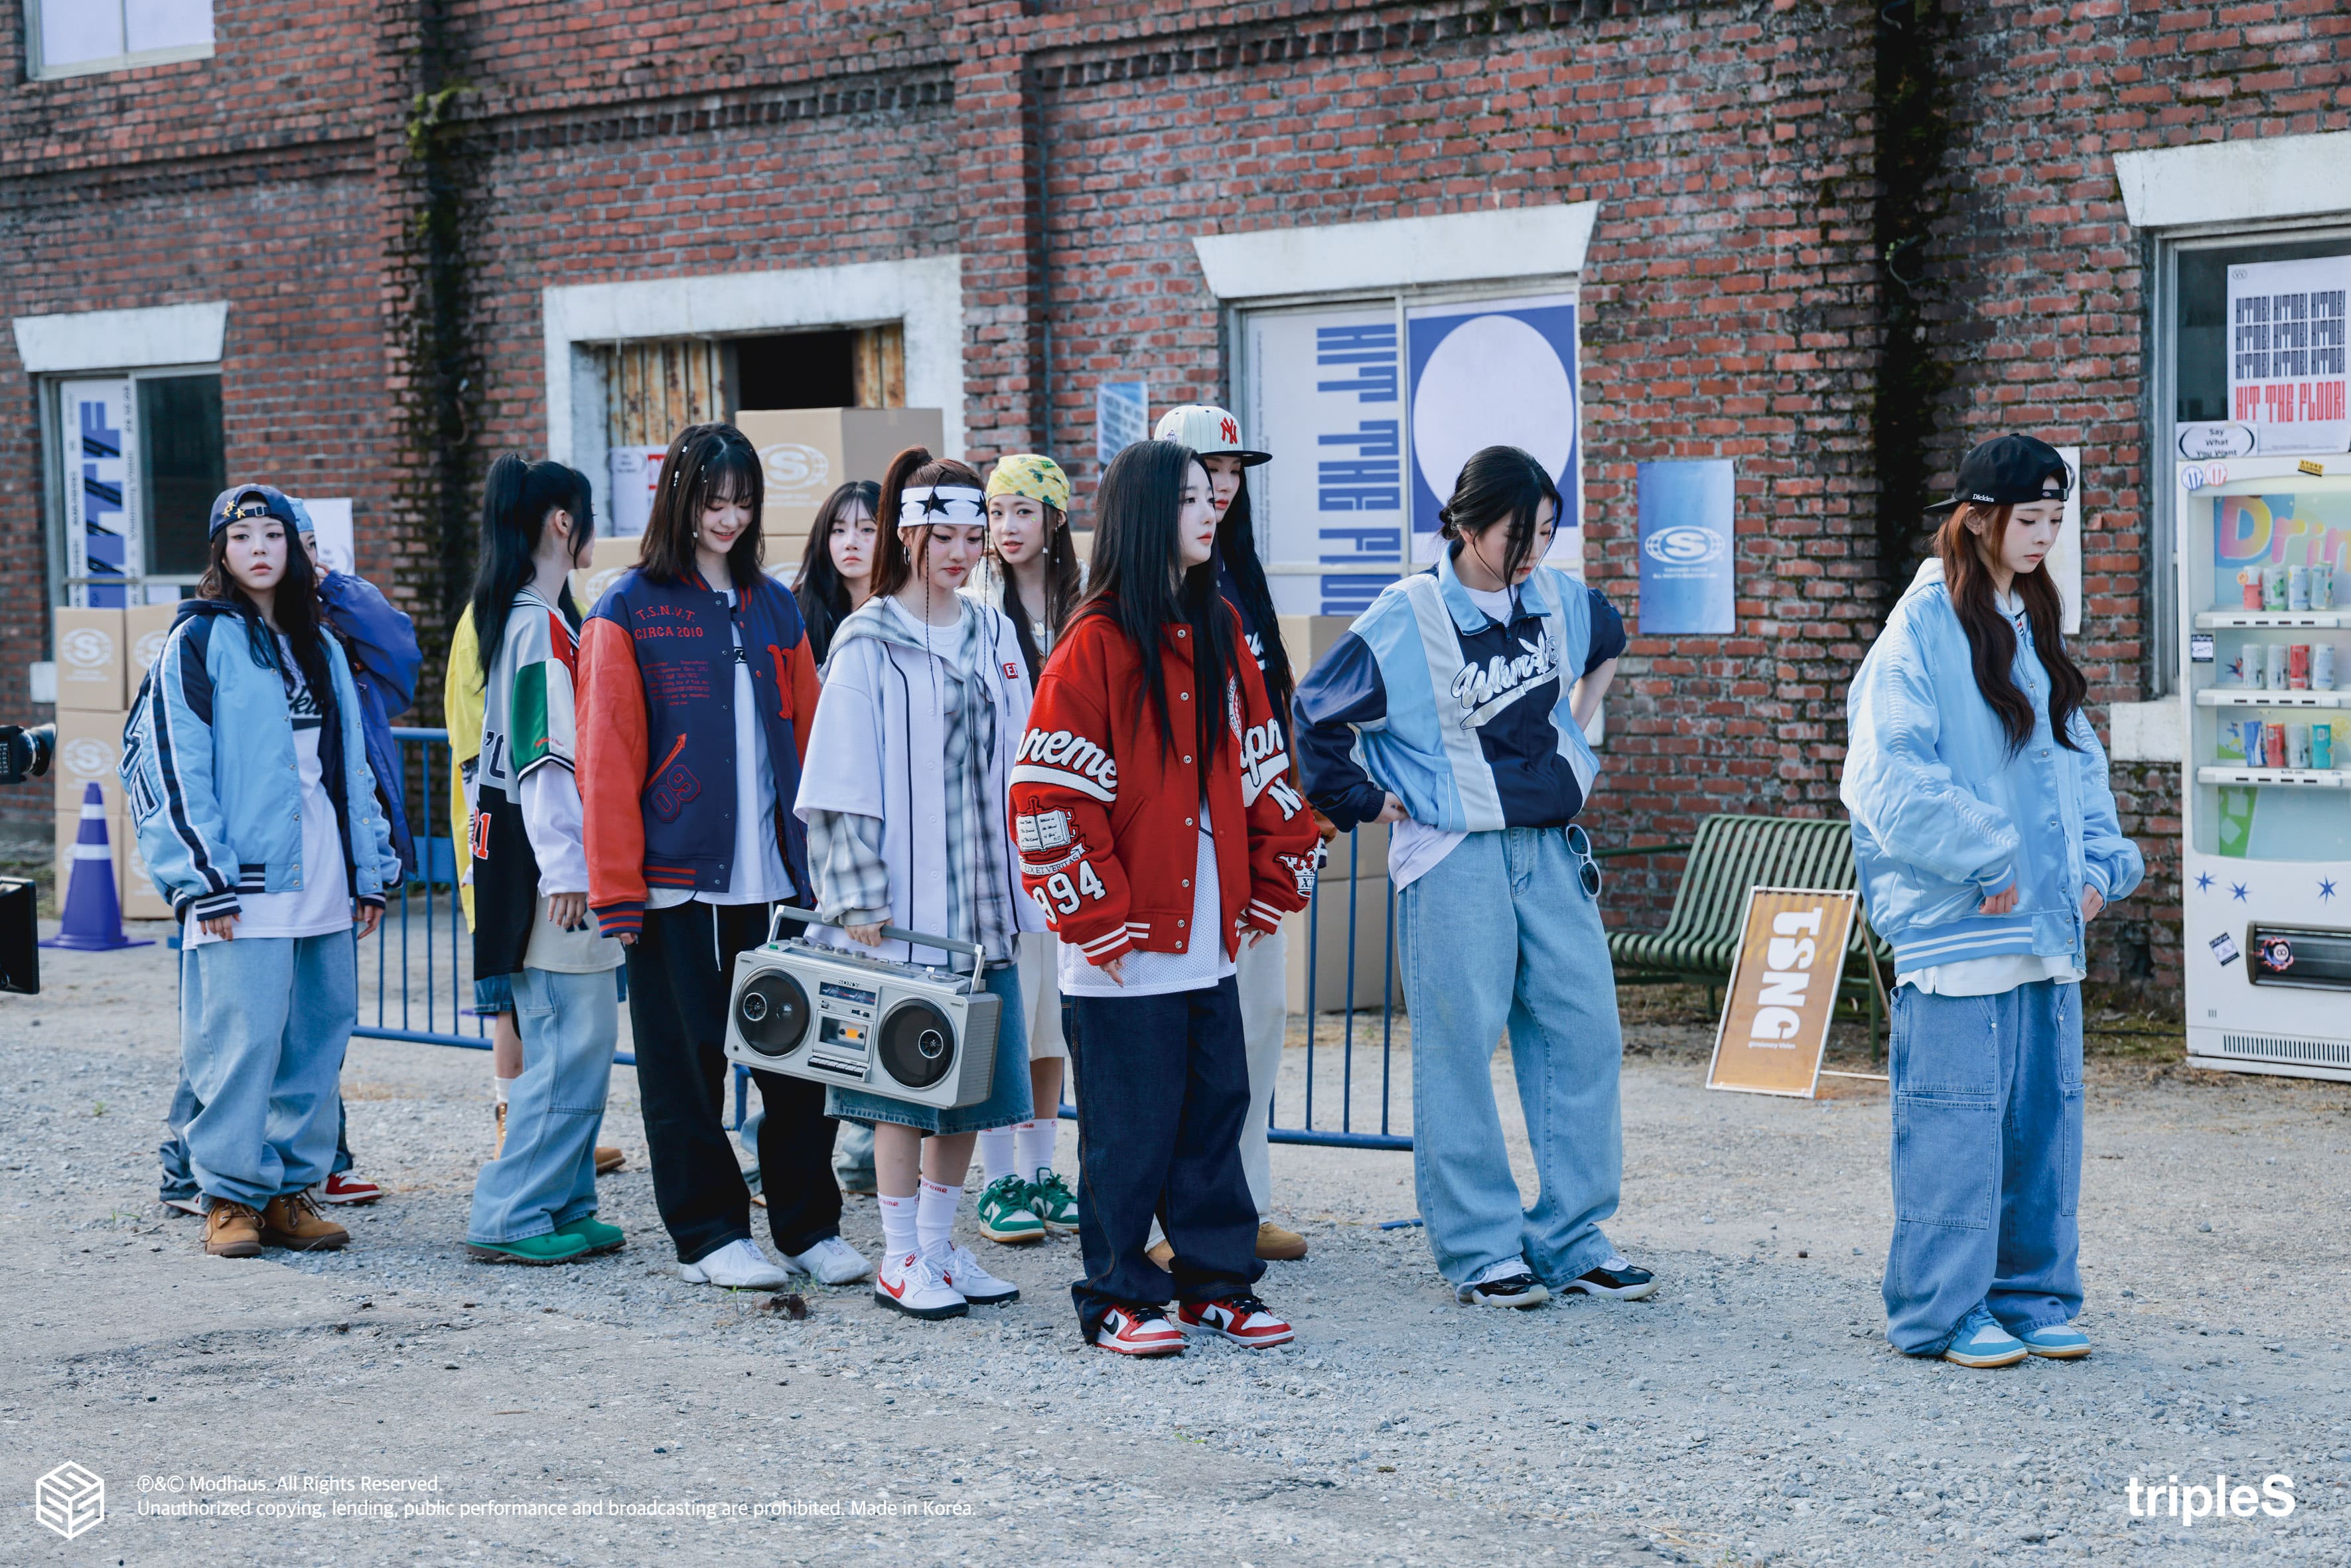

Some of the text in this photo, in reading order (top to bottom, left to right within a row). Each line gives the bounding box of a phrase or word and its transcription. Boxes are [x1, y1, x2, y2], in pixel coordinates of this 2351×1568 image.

[1317, 324, 1398, 403] HIT
[2236, 380, 2346, 423] HIT THE FLOOR!
[1220, 417, 1238, 445] NY
[1318, 419, 1399, 511] THE
[1972, 493, 1995, 502] Dickies
[635, 605, 695, 623] T.S.N.V.T.
[634, 626, 704, 640] CIRCA 2010
[650, 764, 701, 821] 09
[1046, 855, 1080, 873] VERITAS
[838, 979, 860, 988] SONY
[1750, 906, 1823, 1040] TSNG
